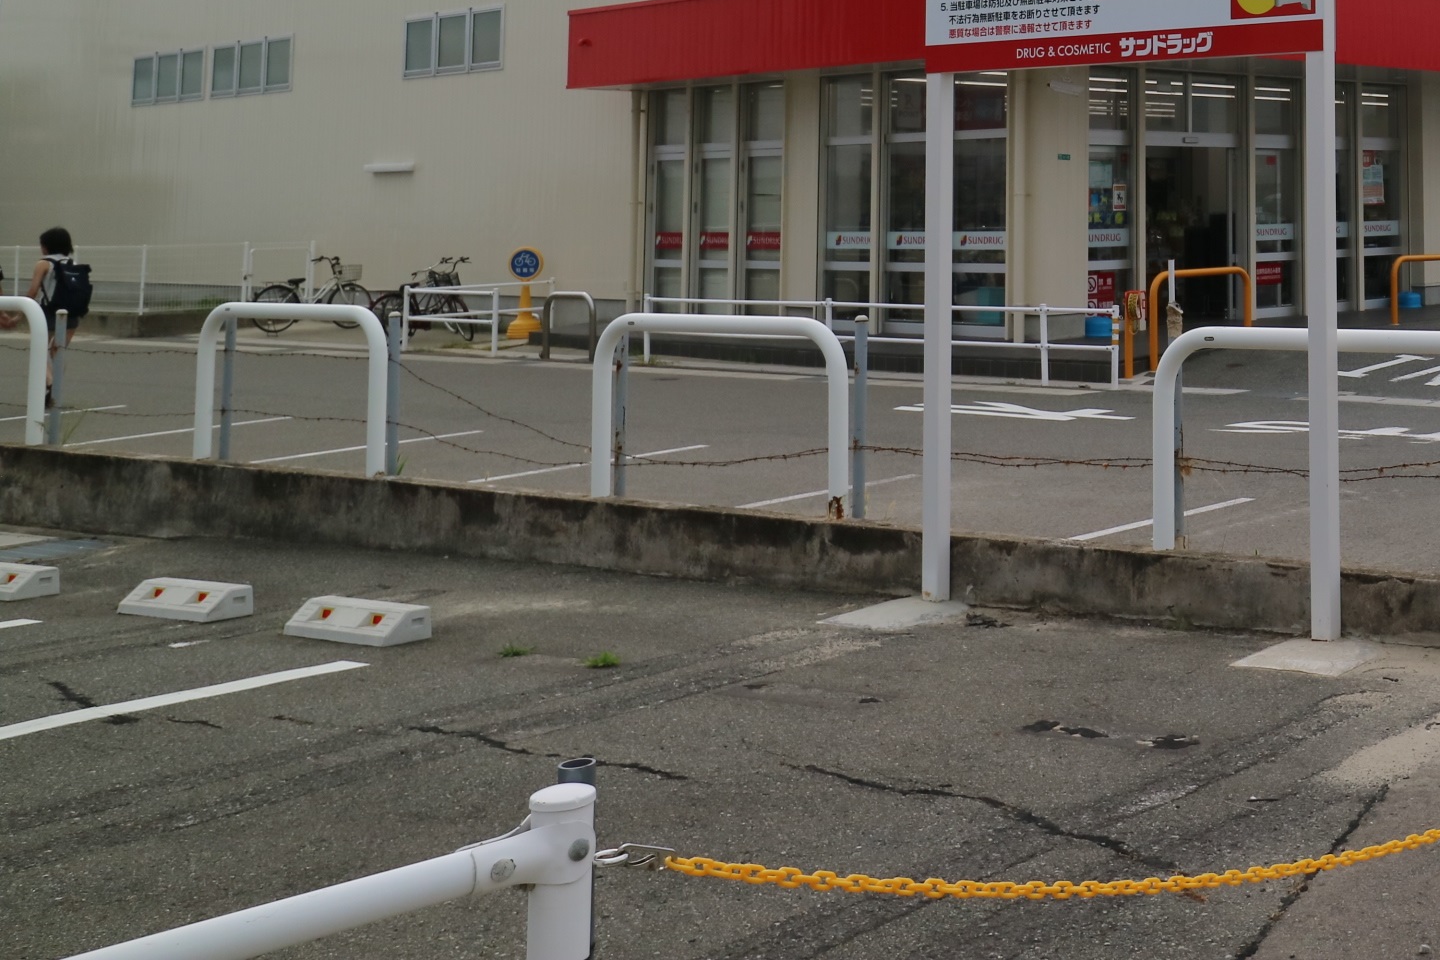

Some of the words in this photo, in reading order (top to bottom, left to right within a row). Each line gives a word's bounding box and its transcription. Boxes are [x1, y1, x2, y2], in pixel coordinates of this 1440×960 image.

[1119, 31, 1213, 57] サンドラッグ
[1016, 47, 1045, 59] DRUG
[1048, 45, 1056, 56] &
[1057, 42, 1112, 56] COSMETIC
[1256, 227, 1288, 237] SUNDRUG
[1364, 224, 1392, 233] SUNDRUG
[968, 235, 1003, 245] SUNDRUG
[1089, 233, 1121, 242] UNDRUG
